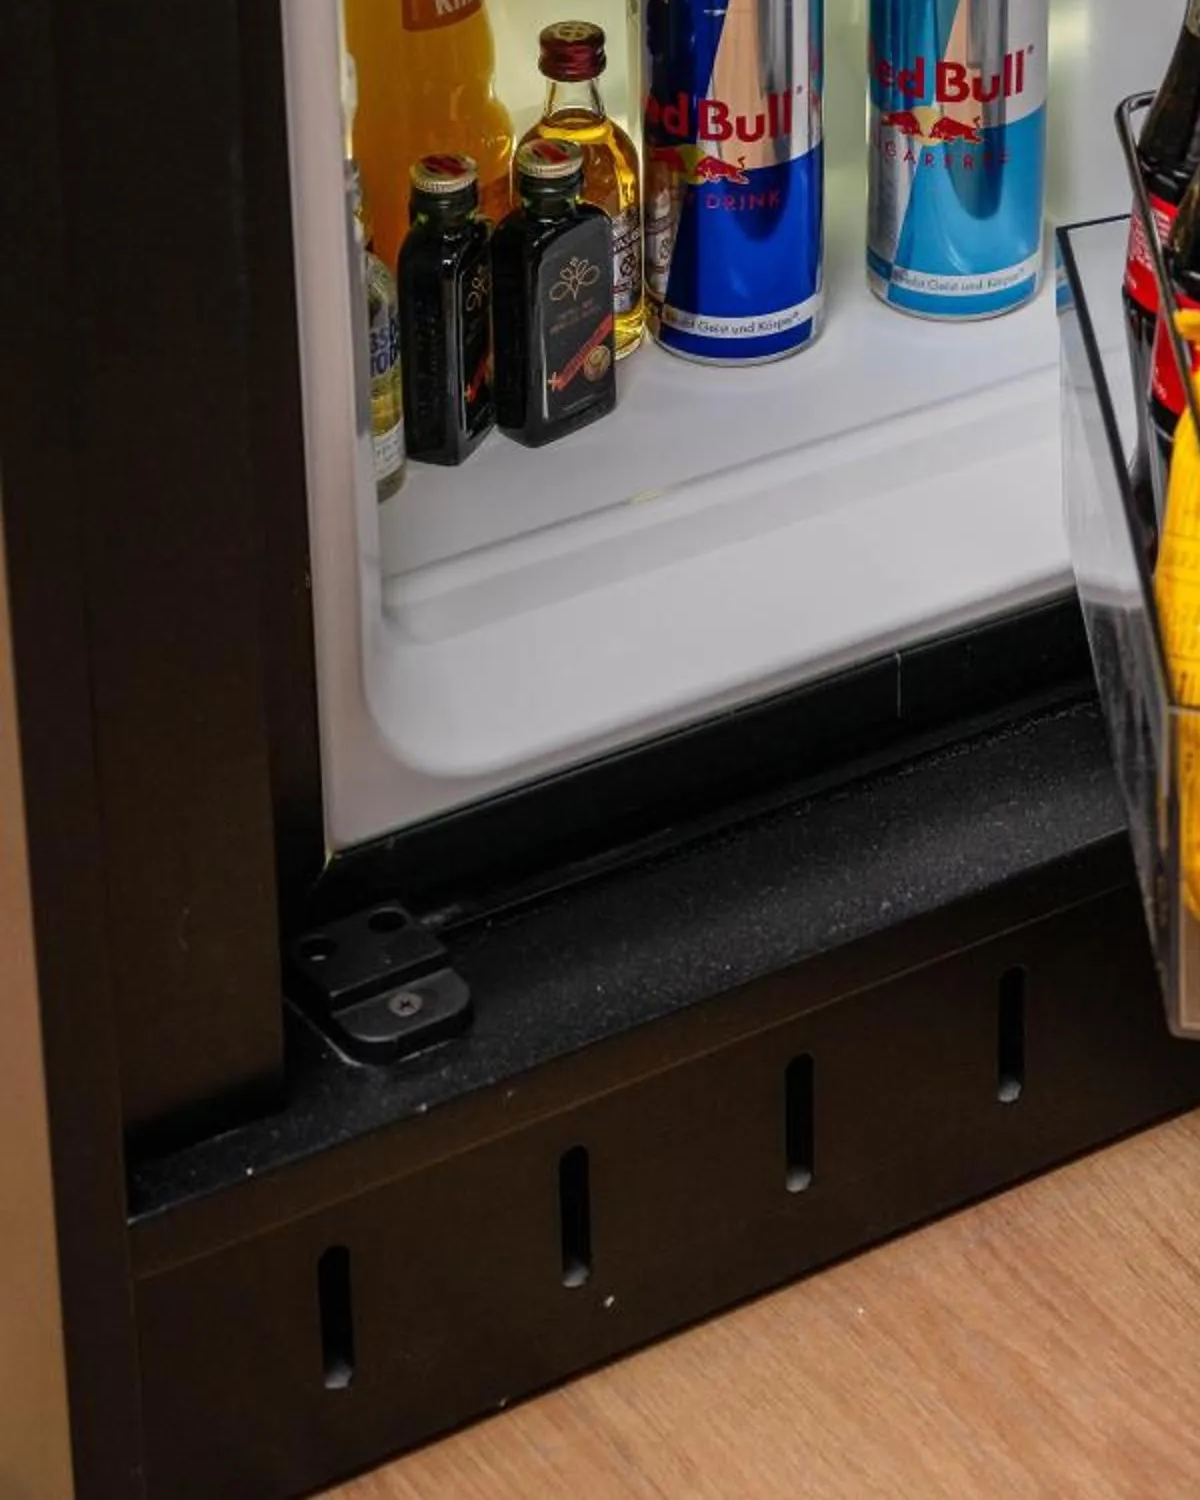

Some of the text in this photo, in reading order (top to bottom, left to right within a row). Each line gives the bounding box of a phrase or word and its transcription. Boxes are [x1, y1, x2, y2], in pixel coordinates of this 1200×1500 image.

[872, 49, 1025, 104] ed Bull
[699, 90, 792, 143] Bull
[705, 189, 781, 213] DRINK
